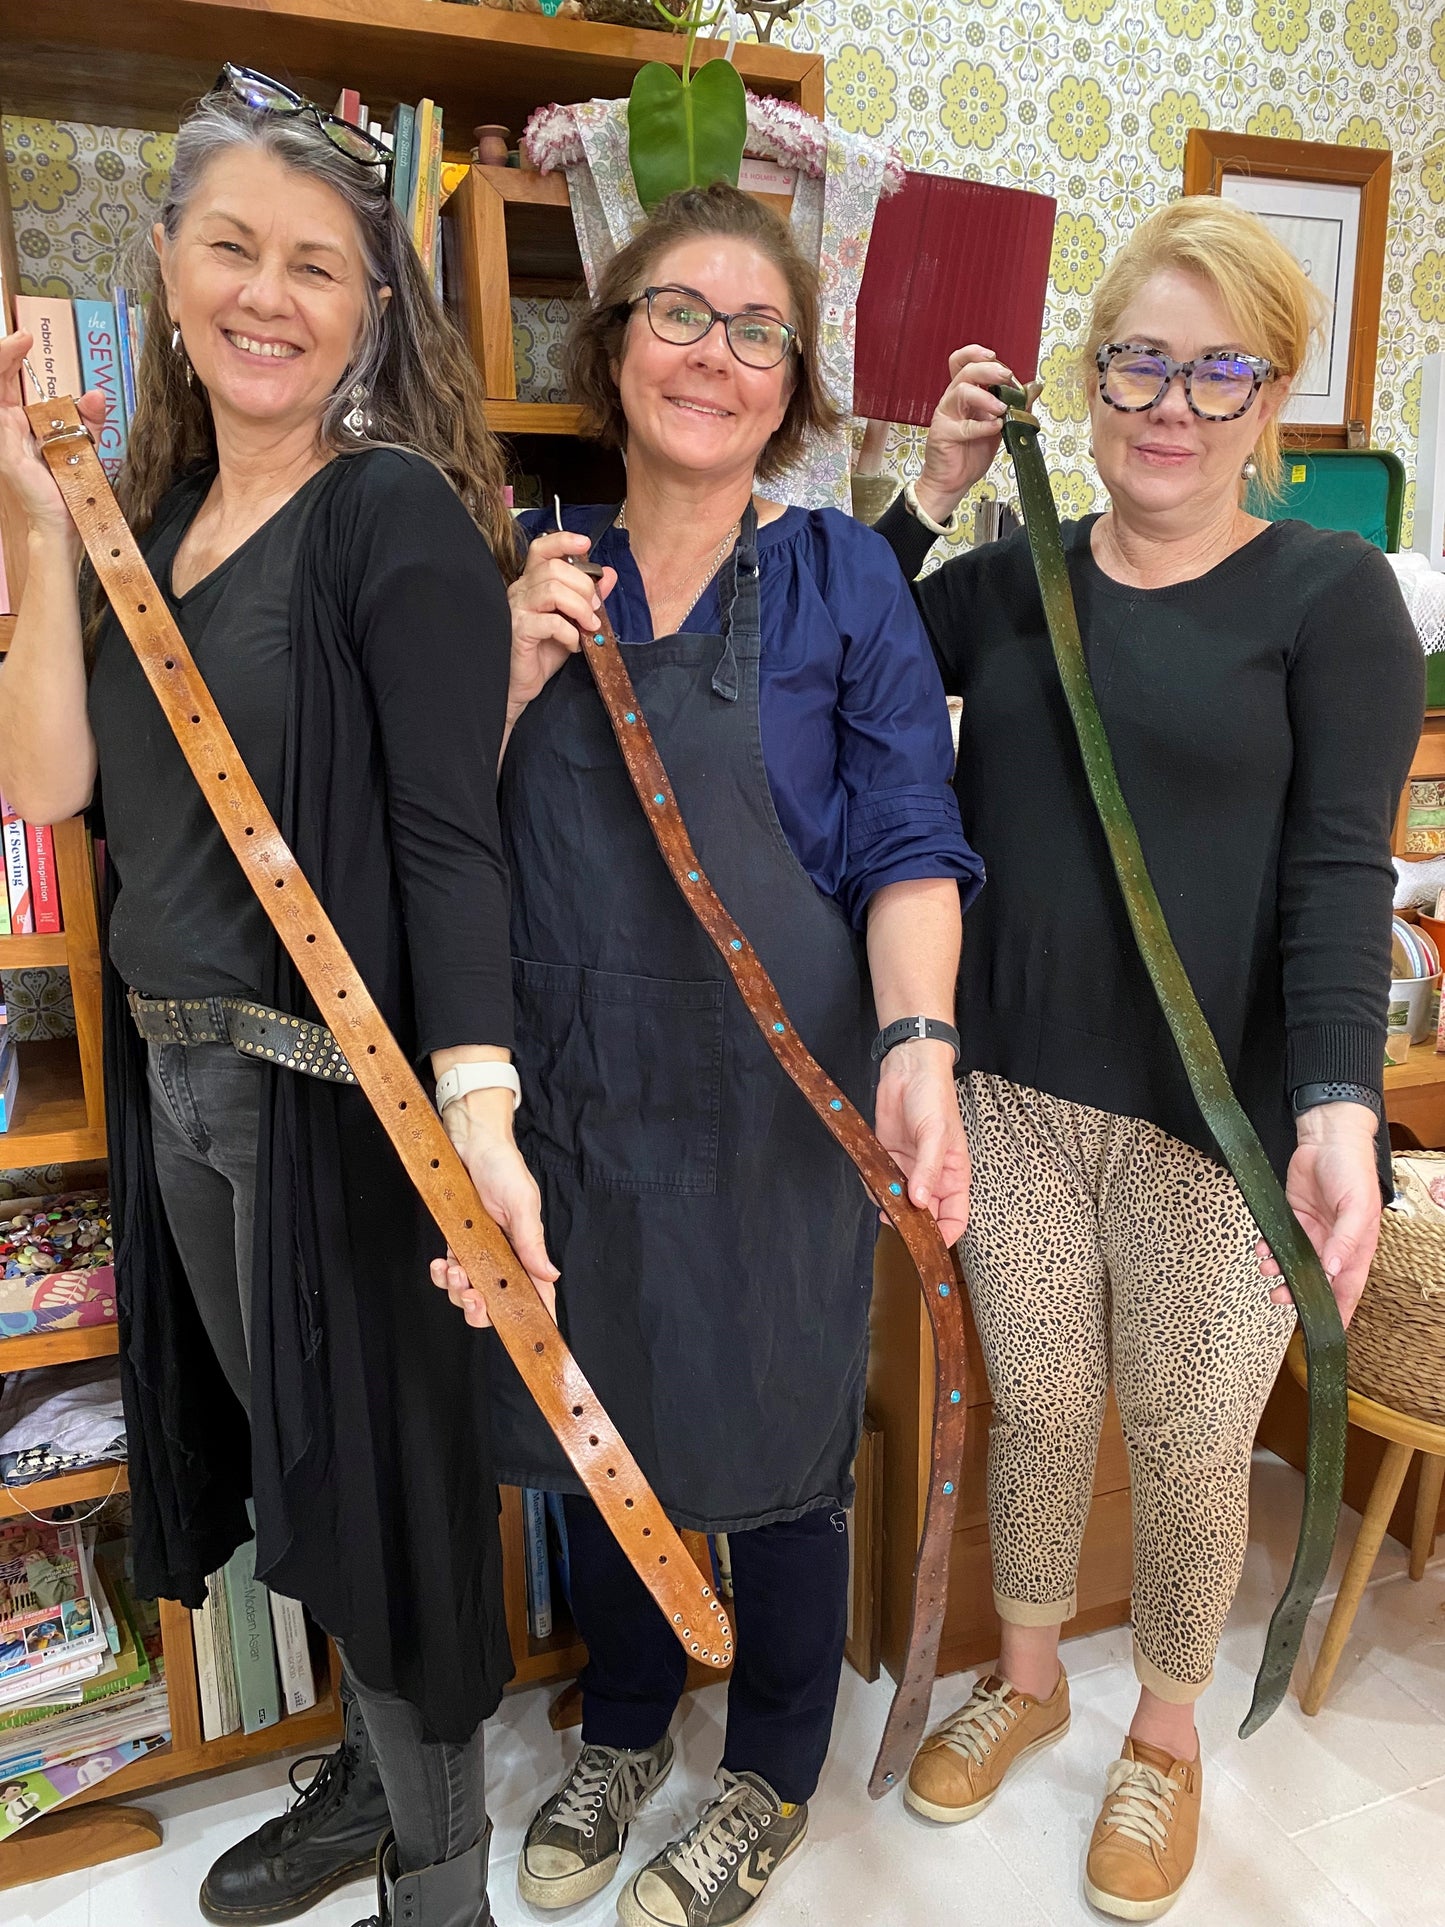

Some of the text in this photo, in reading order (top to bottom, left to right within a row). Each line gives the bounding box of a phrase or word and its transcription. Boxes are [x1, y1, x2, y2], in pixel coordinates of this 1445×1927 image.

[399, 115, 412, 167] Slow Stitch
[750, 172, 777, 182] HOLMES
[87, 311, 106, 330] the
[40, 317, 58, 398] Fabric for Fas
[87, 330, 123, 449] SEWING
[9, 821, 22, 837] of
[35, 826, 47, 855] itional
[10, 838, 26, 887] Sewing
[37, 856, 50, 902] Inspiration
[532, 1491, 543, 1517] More
[533, 1517, 544, 1539] Slow
[535, 1539, 546, 1577] Cooking
[243, 1588, 259, 1632] Modern
[249, 1632, 263, 1662] Asian
[53, 1692, 107, 1716] EMBROIDERY
